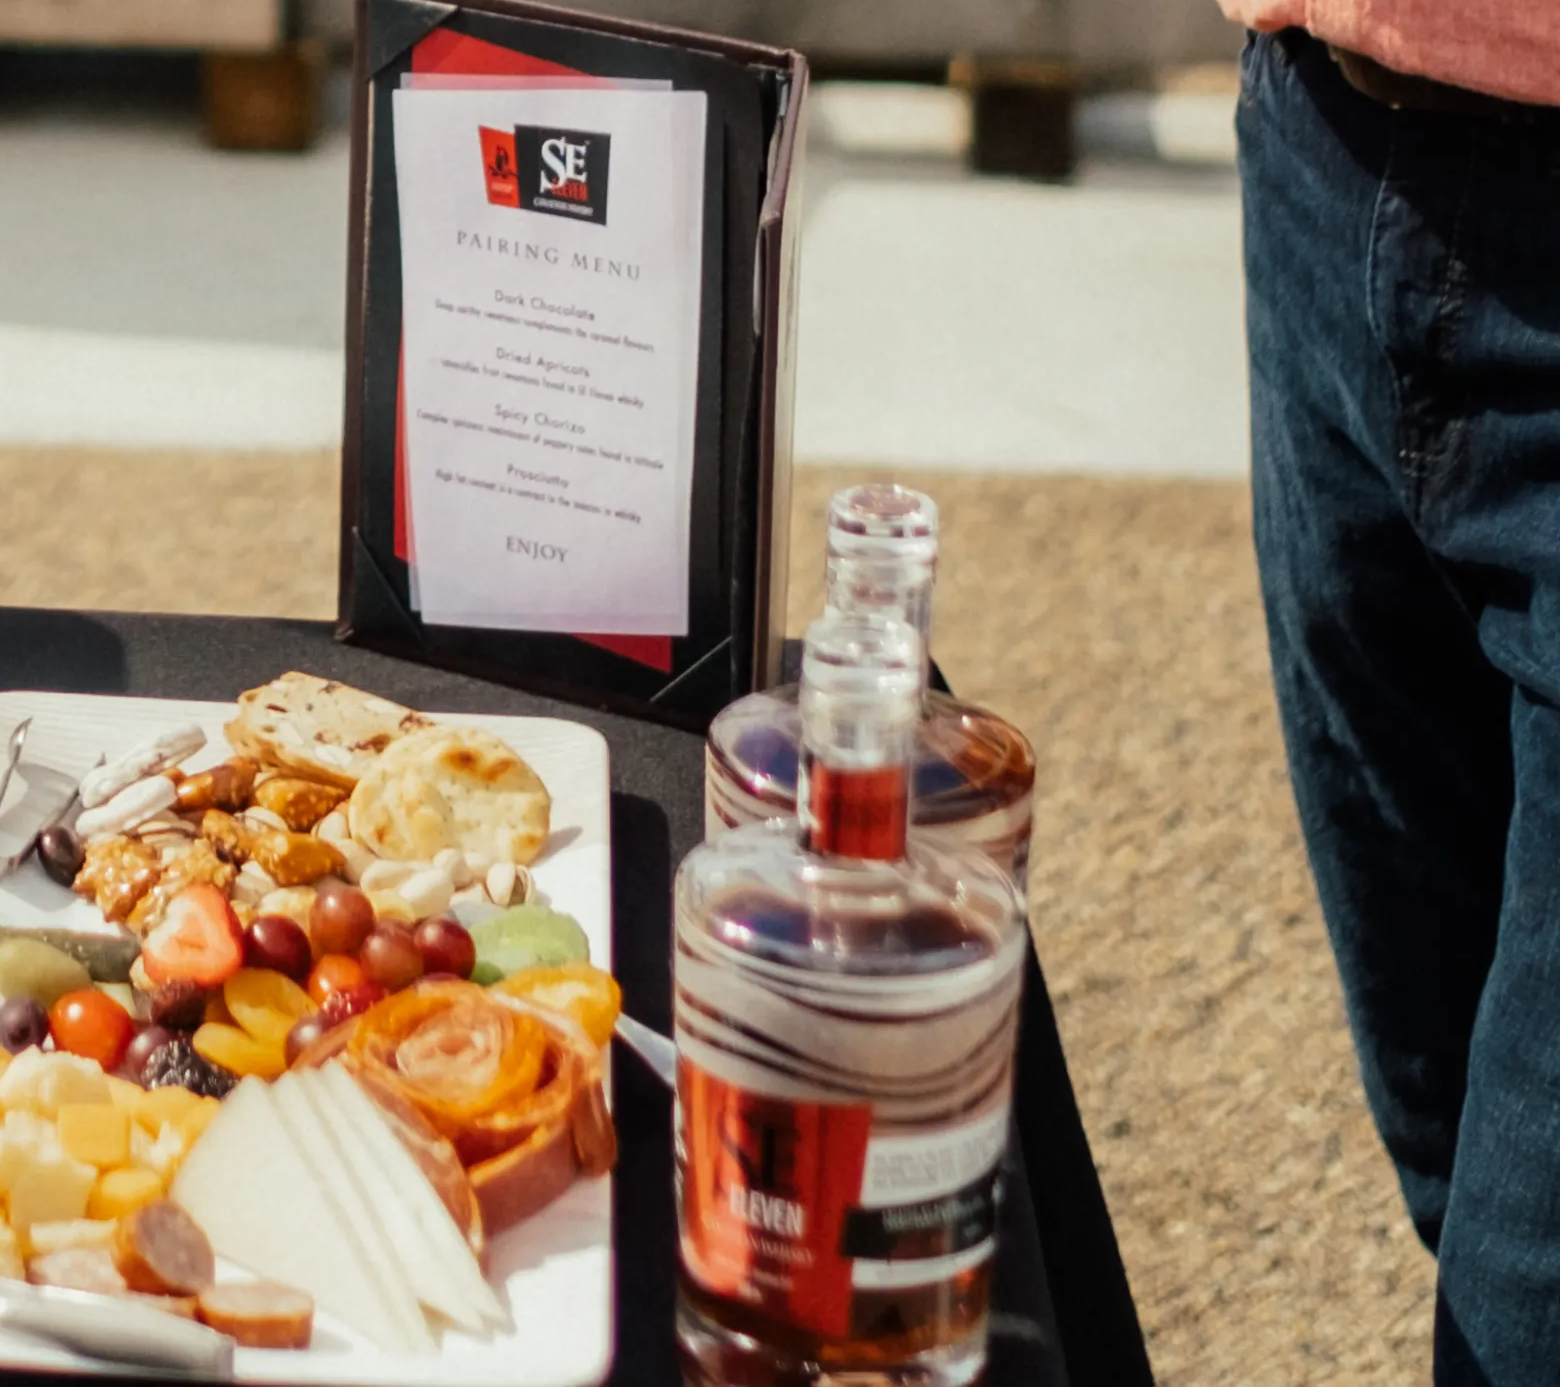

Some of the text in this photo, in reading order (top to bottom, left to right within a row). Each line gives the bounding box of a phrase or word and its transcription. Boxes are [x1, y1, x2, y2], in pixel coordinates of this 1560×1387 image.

[540, 136, 588, 194] SE
[456, 230, 641, 282] PAIRING MENU
[494, 289, 525, 307] Dark
[530, 296, 595, 322] Chocolate
[495, 346, 532, 366] Dried
[536, 356, 591, 378] Apricots
[494, 403, 529, 426] Spicy
[534, 412, 586, 435] Chorizo
[506, 535, 569, 563] ENJOY
[729, 1181, 805, 1240] ELEVEN
